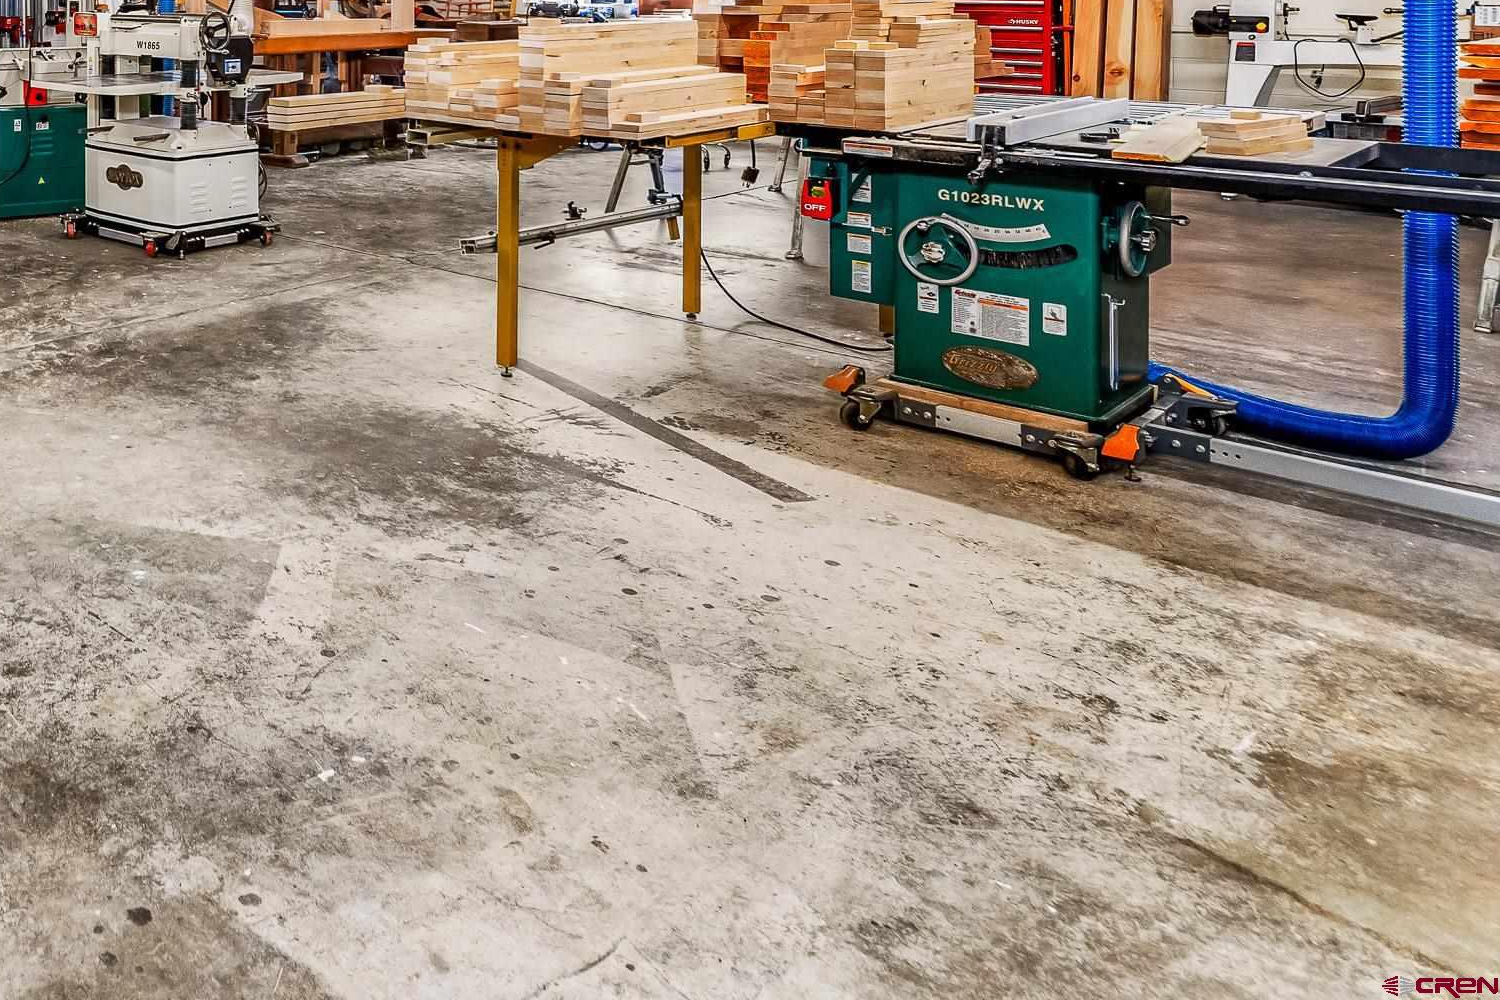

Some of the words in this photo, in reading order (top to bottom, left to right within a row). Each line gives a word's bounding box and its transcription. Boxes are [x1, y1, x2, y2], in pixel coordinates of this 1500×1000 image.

[136, 40, 160, 50] W1865
[938, 188, 1045, 212] G1023RLWX
[804, 202, 827, 213] OFF
